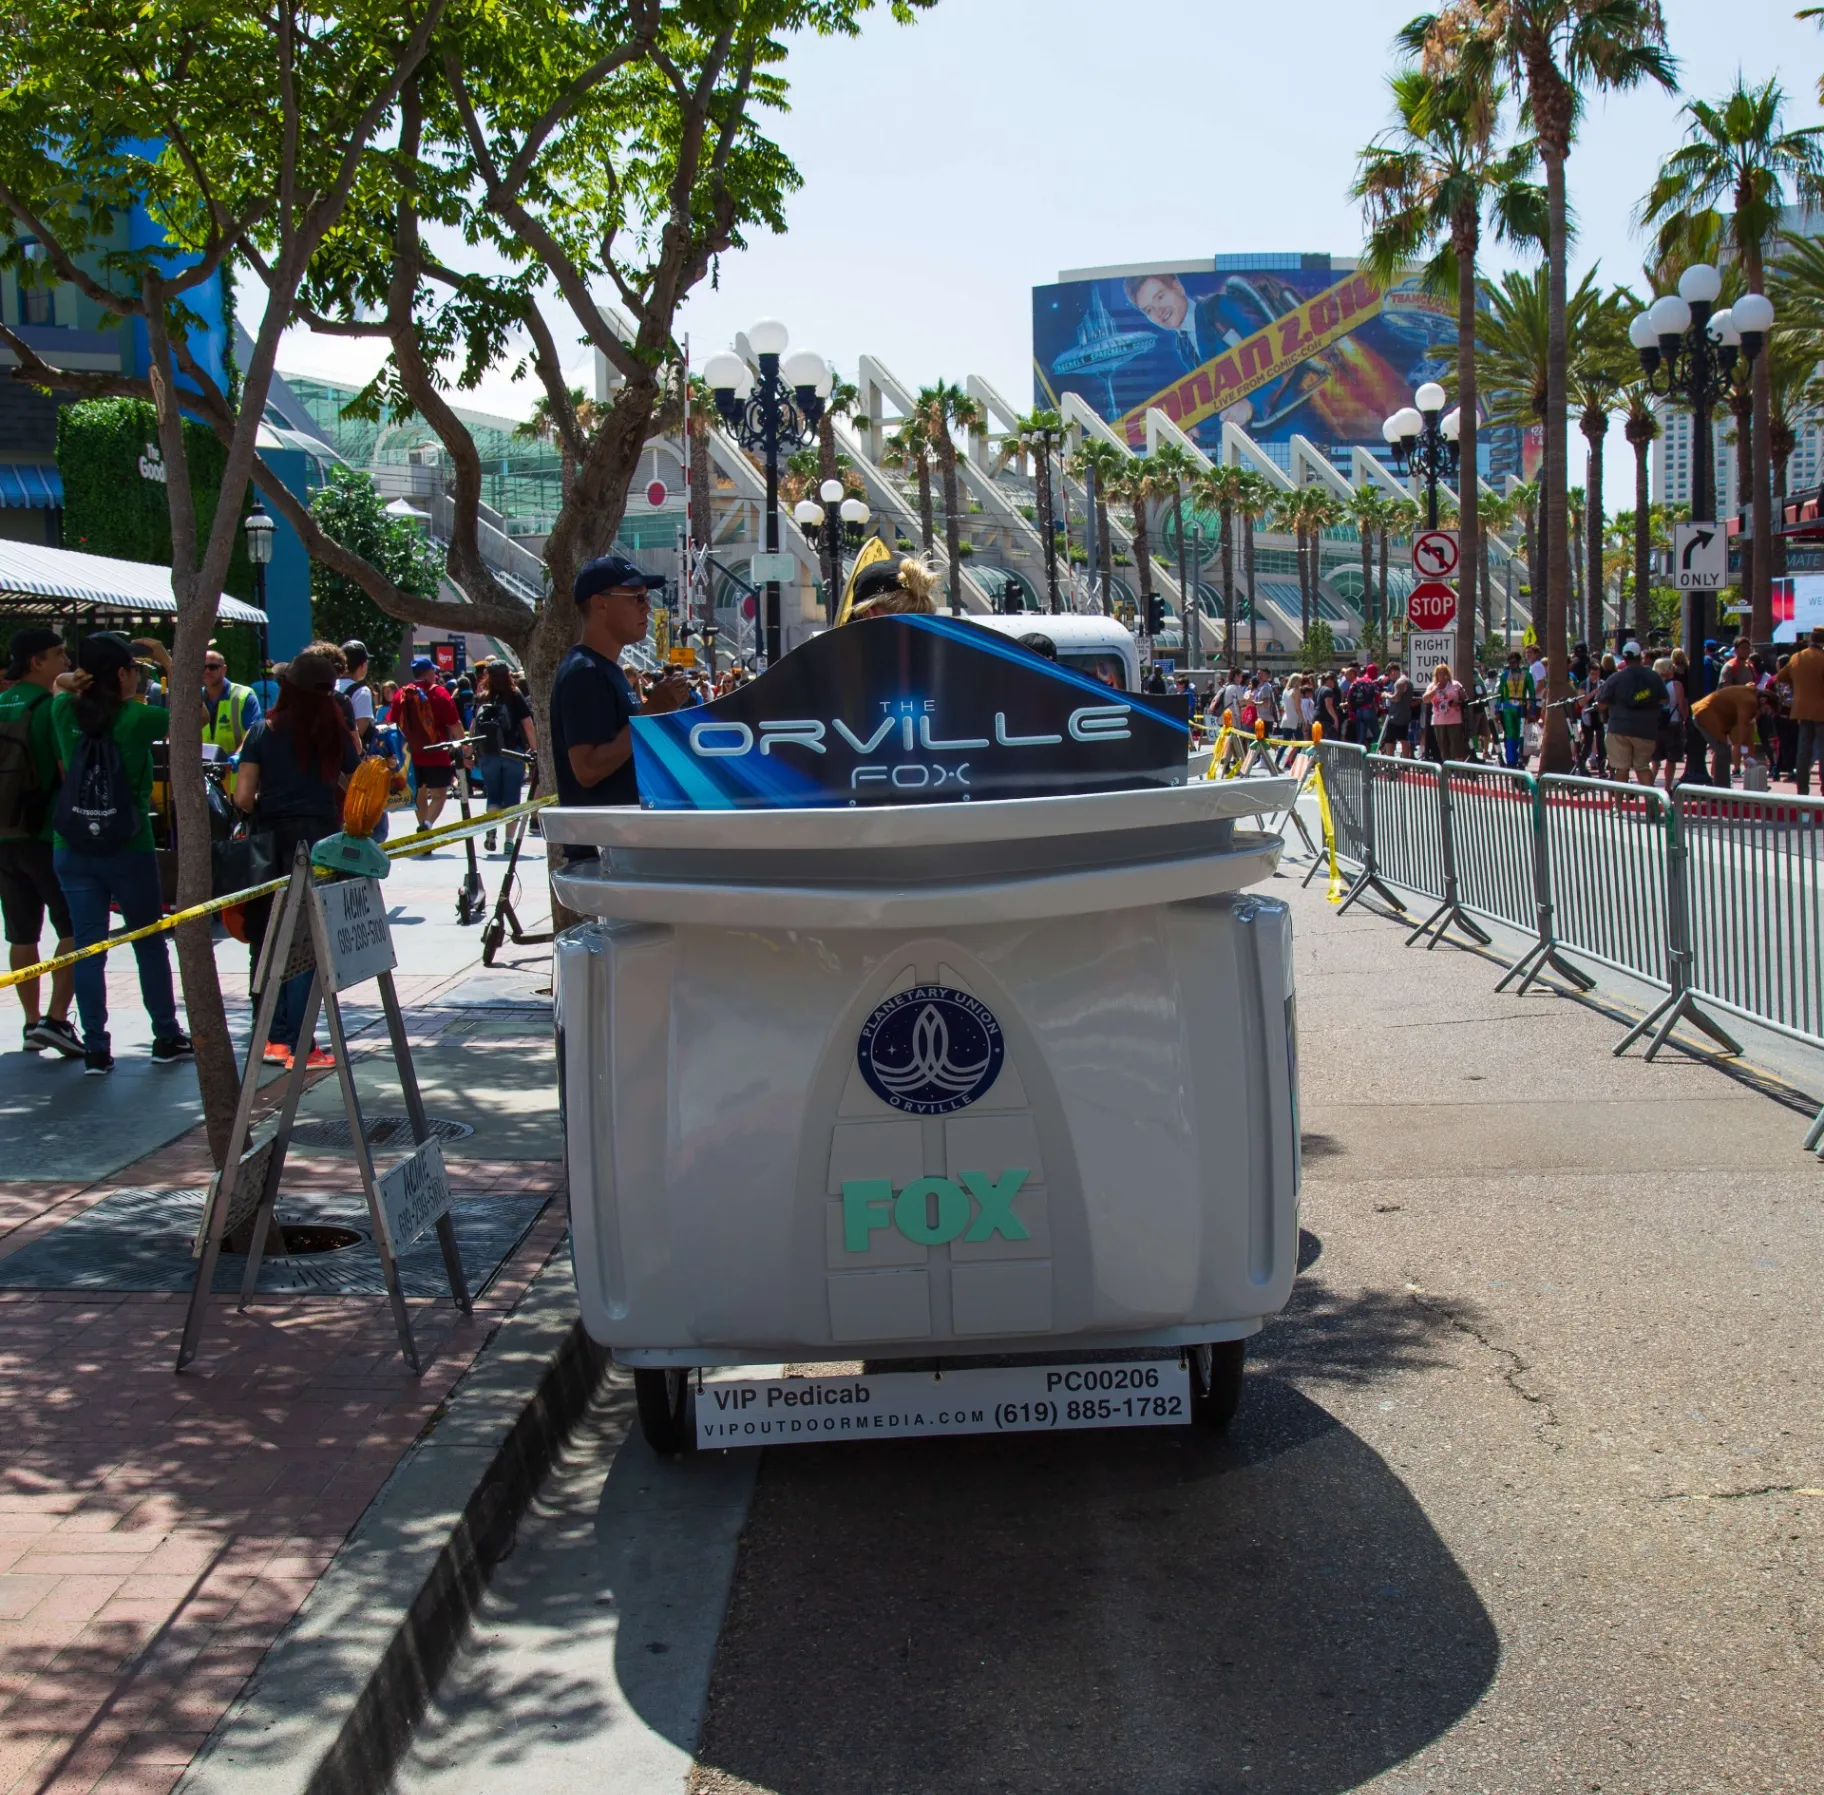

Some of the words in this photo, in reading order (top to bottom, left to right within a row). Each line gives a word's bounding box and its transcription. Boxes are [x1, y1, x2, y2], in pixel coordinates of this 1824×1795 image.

[1213, 390, 1236, 411] LIVE
[1237, 374, 1265, 396] FROM
[1266, 339, 1323, 377] COMIC-CON
[138, 455, 167, 483] Good
[1680, 573, 1720, 586] ONLY
[1411, 596, 1453, 616] STOP
[1414, 639, 1451, 651] RIGHT
[1416, 655, 1449, 667] TURN
[880, 700, 937, 713] THE
[688, 704, 1132, 757] ORVILLE
[851, 762, 971, 790] FOX
[343, 885, 370, 921] ACME
[861, 987, 949, 1038] PLANETARY
[954, 992, 1000, 1035] UNION
[889, 1093, 972, 1114] ORVILLE
[841, 1168, 1032, 1252] FOX
[1046, 1367, 1160, 1393] PC00206
[713, 1388, 757, 1411] VIP
[767, 1383, 871, 1408] Pedicab
[704, 1410, 984, 1437] VIPOUTDOORMEDIA.COM
[994, 1400, 1058, 1429] (619)
[1066, 1396, 1183, 1421] 885-1782
